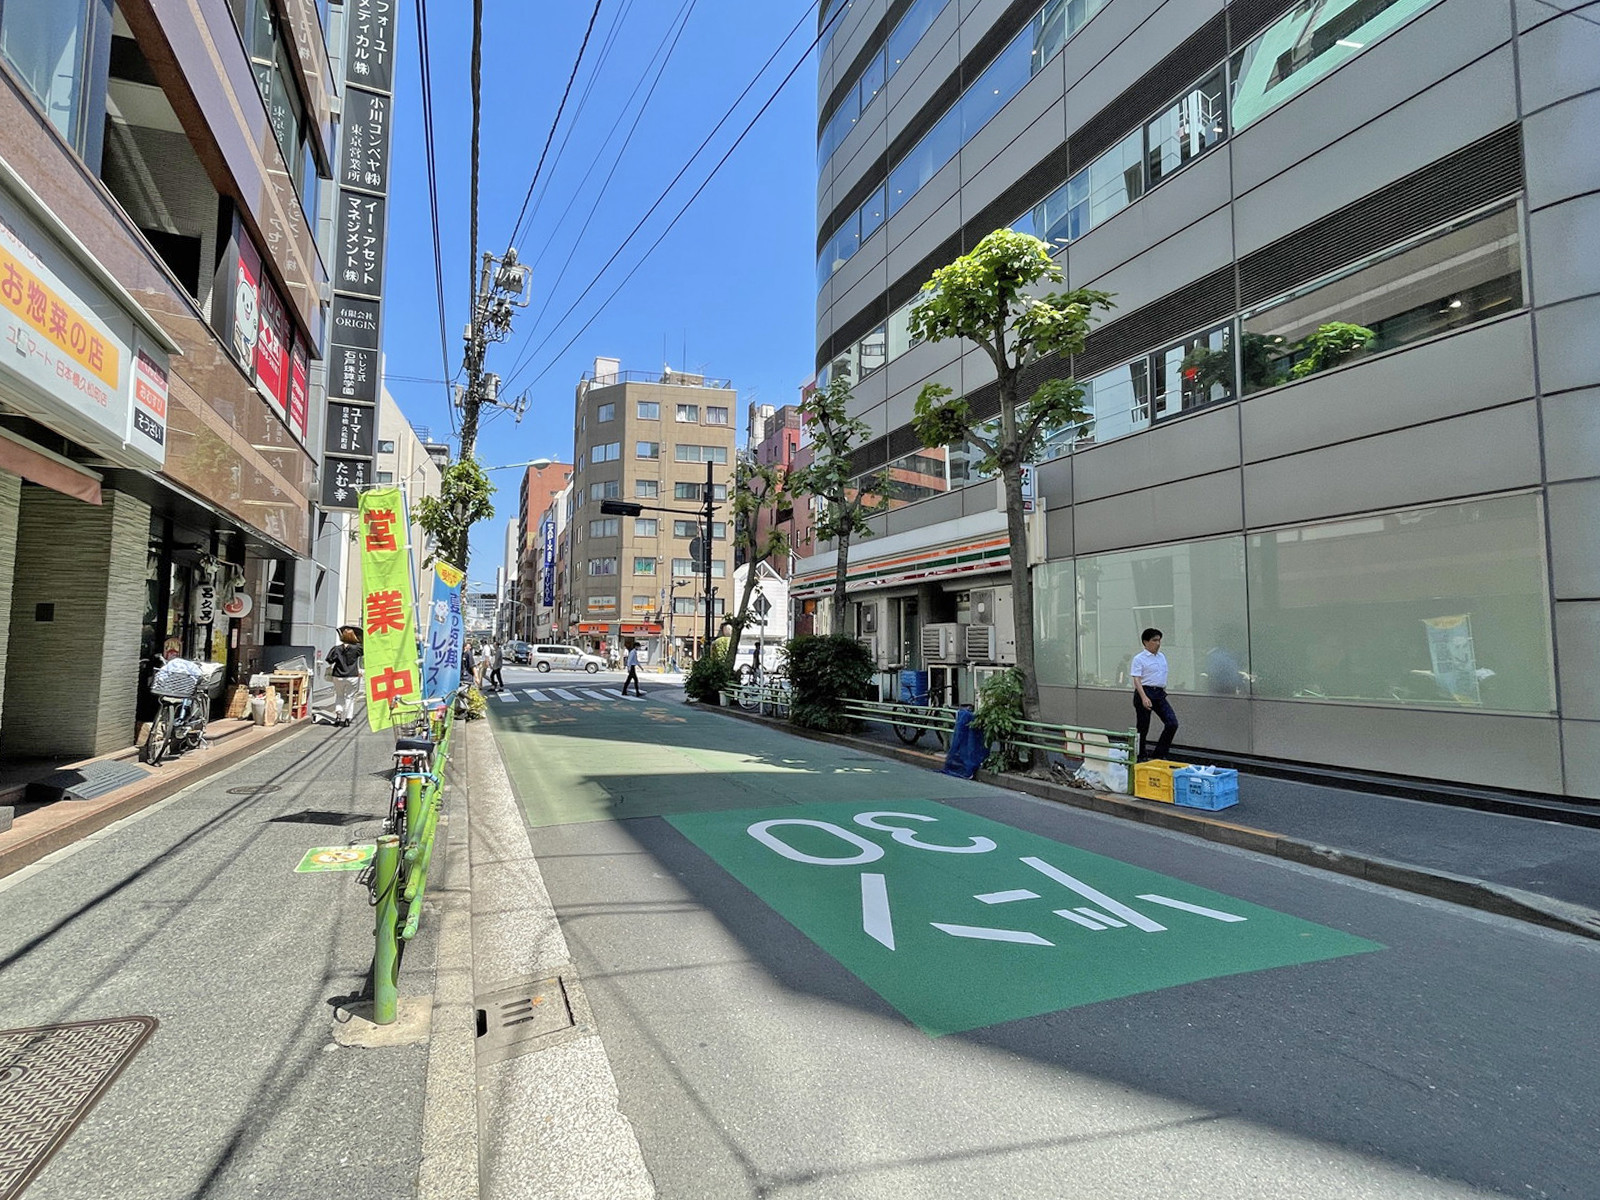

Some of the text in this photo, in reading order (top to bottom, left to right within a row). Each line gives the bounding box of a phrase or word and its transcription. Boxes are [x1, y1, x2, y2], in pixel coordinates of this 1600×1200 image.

[373, 1, 390, 64] フォーユー
[347, 124, 363, 182] 東京営業所
[1, 262, 105, 372] お惣菜の店
[335, 317, 376, 330] ORIGIN
[340, 308, 373, 320] 有限会社
[6, 325, 53, 367] ユマート
[357, 352, 367, 382] いしど式
[138, 413, 161, 440] そうざい
[350, 407, 362, 451] ユーマート
[334, 461, 349, 502] たむ幸
[363, 508, 414, 709] 営業中
[747, 811, 998, 867] 30
